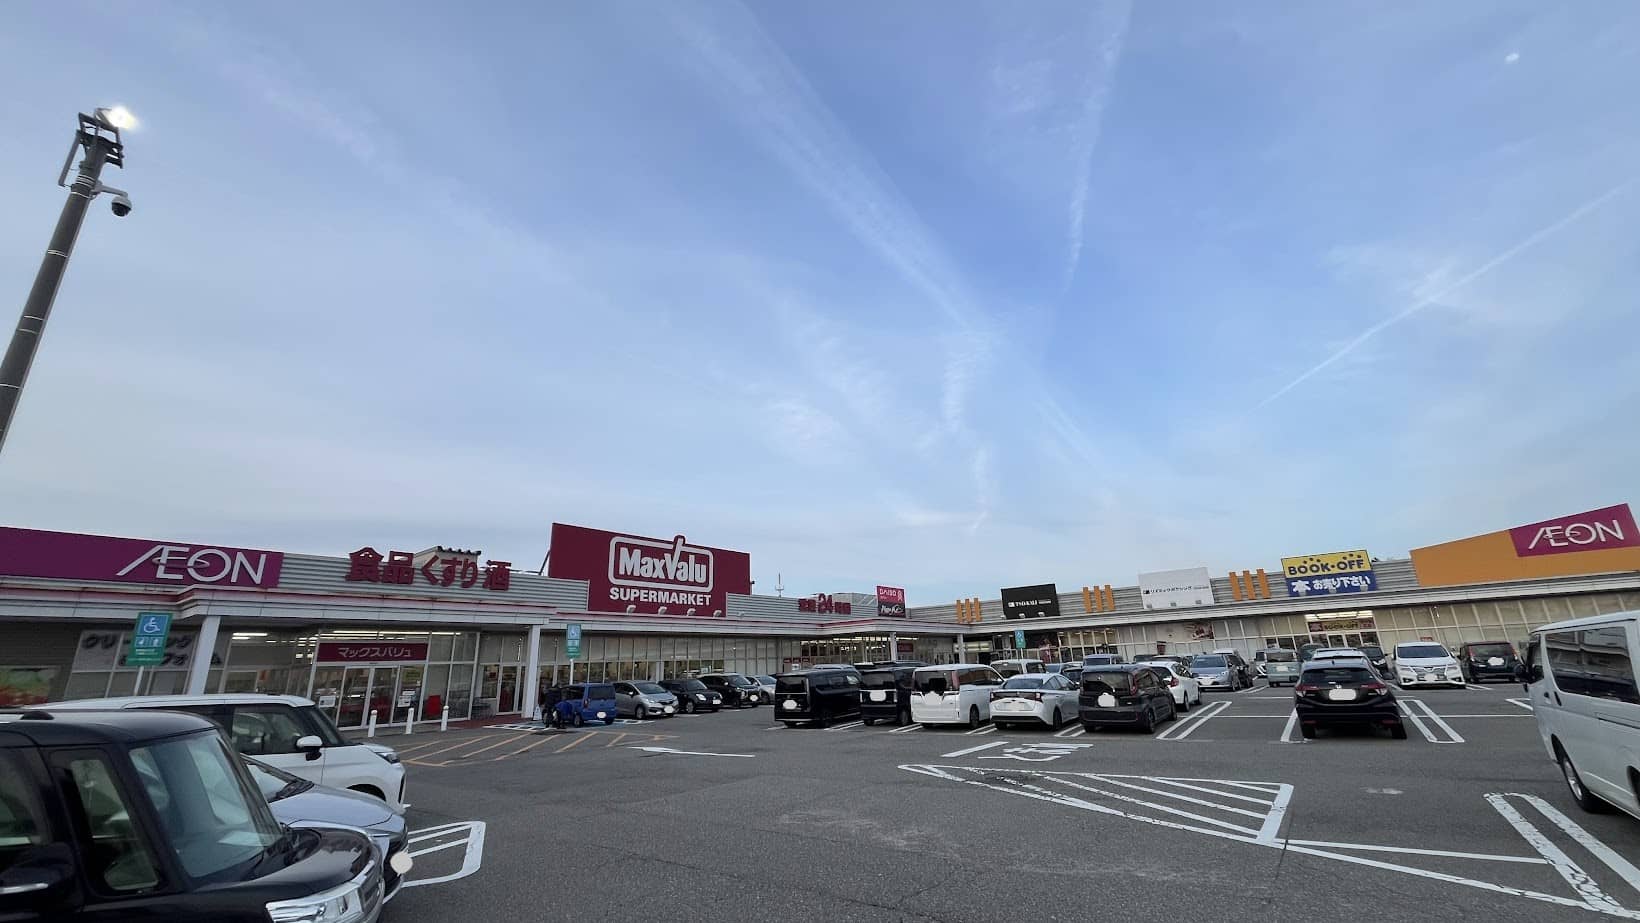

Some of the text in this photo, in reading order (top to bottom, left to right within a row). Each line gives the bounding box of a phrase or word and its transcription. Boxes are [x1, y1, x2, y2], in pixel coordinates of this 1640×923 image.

[421, 555, 478, 589] くすり
[482, 560, 512, 591] 酒
[619, 538, 707, 584] MaxValu
[609, 587, 712, 606] SUPERMARKET
[338, 647, 411, 657] マックスバリュ
